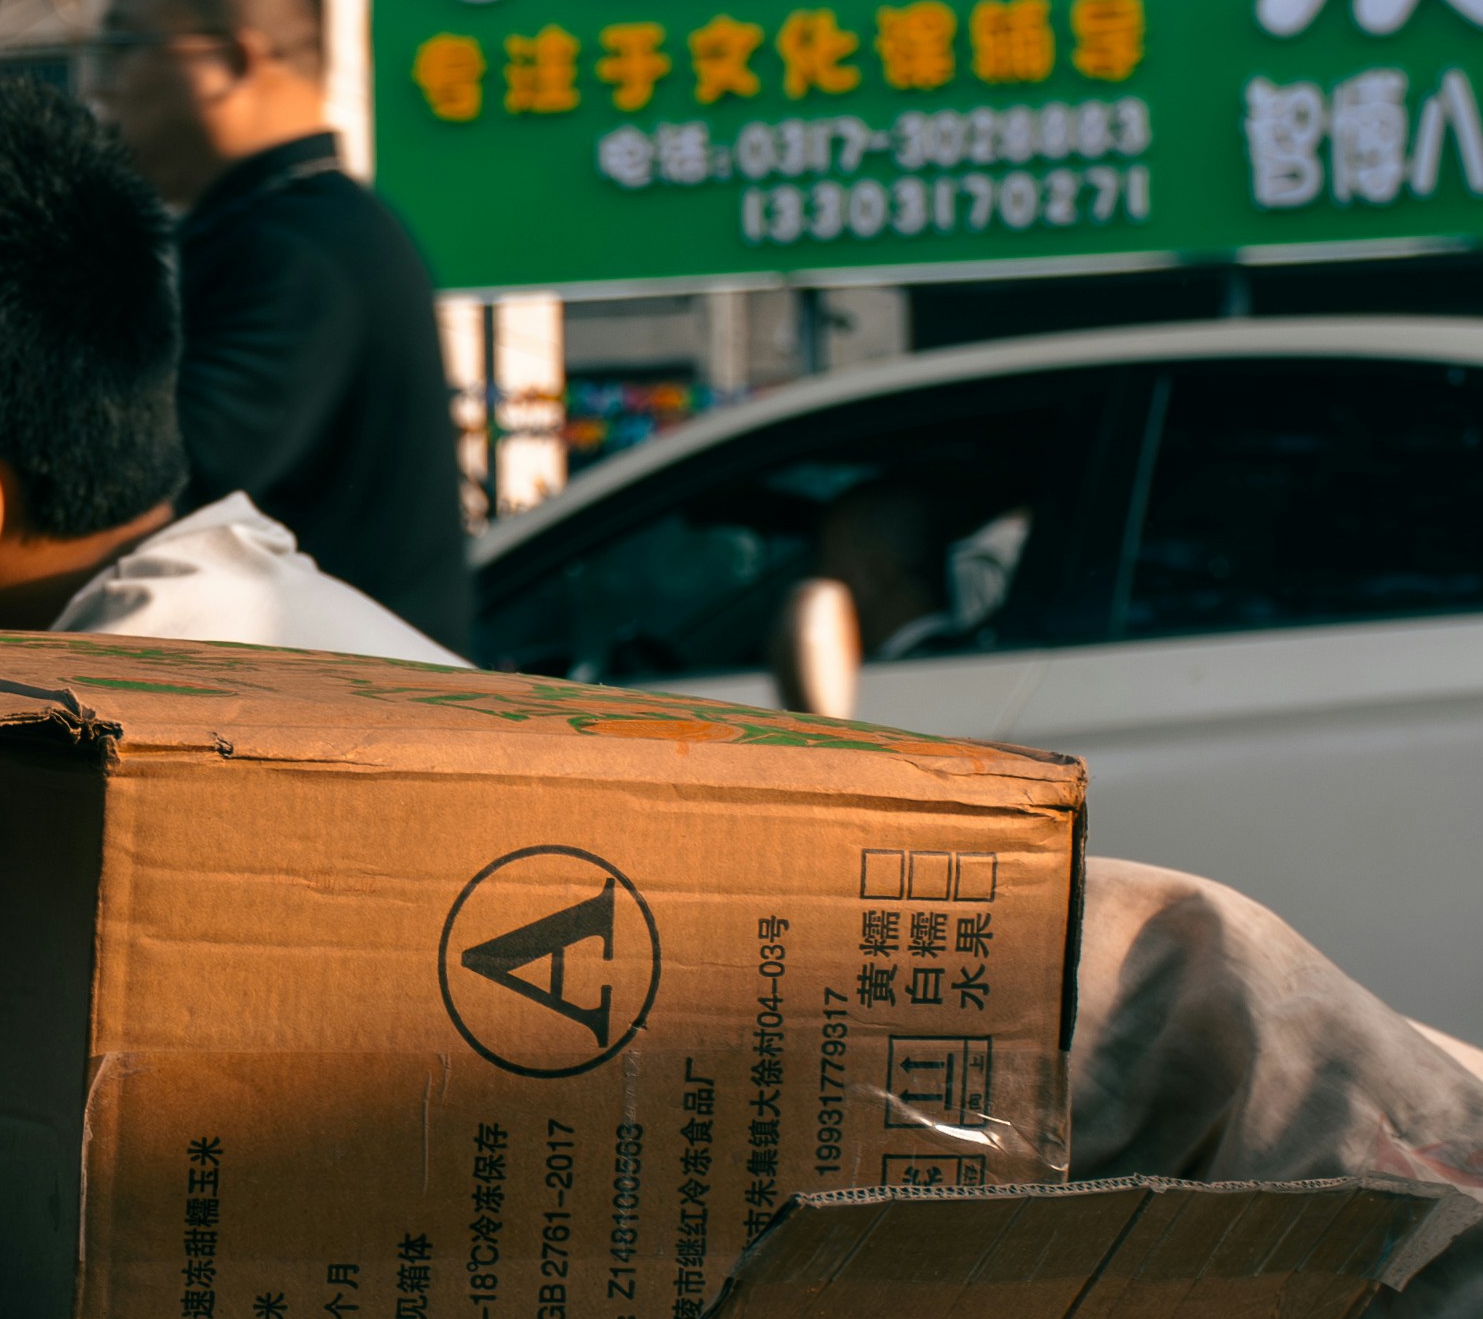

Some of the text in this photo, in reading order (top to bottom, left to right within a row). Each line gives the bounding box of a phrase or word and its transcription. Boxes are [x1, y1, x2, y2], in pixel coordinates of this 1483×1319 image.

[741, 166, 1151, 242] 13303170271
[461, 878, 615, 1048] A
[856, 910, 900, 1008] 黄糯
[906, 911, 949, 1004] 白糯
[952, 912, 995, 1010] 水果
[743, 915, 790, 1250] 市朱集镇大徐村04-03号
[815, 988, 850, 1176] 19931779317
